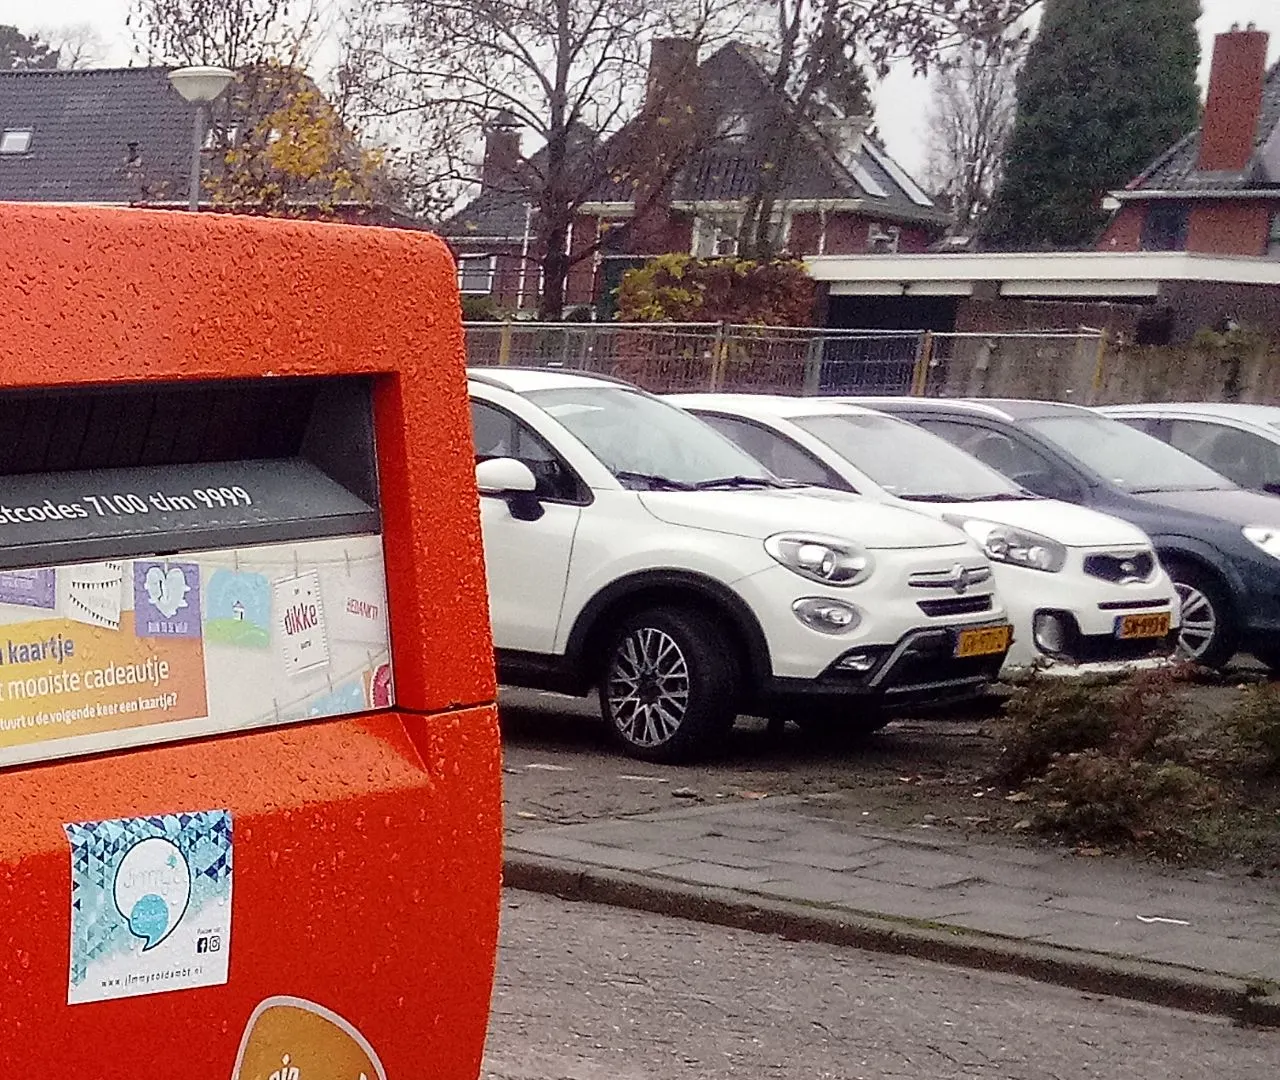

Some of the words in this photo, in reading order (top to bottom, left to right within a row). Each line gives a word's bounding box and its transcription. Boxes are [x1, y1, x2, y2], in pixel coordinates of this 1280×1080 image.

[83, 493, 149, 516] 7100
[149, 492, 198, 512] t/m
[193, 486, 253, 508] 9999
[284, 602, 318, 636] dikke
[8, 633, 74, 664] kaartje
[7, 668, 80, 699] mooiste
[84, 655, 169, 689] cadeautje
[27, 715, 35, 727] u
[36, 711, 49, 725] de
[49, 704, 95, 726] volgende
[96, 700, 118, 716] keer
[119, 699, 138, 712] een
[139, 692, 178, 711] kaartje?
